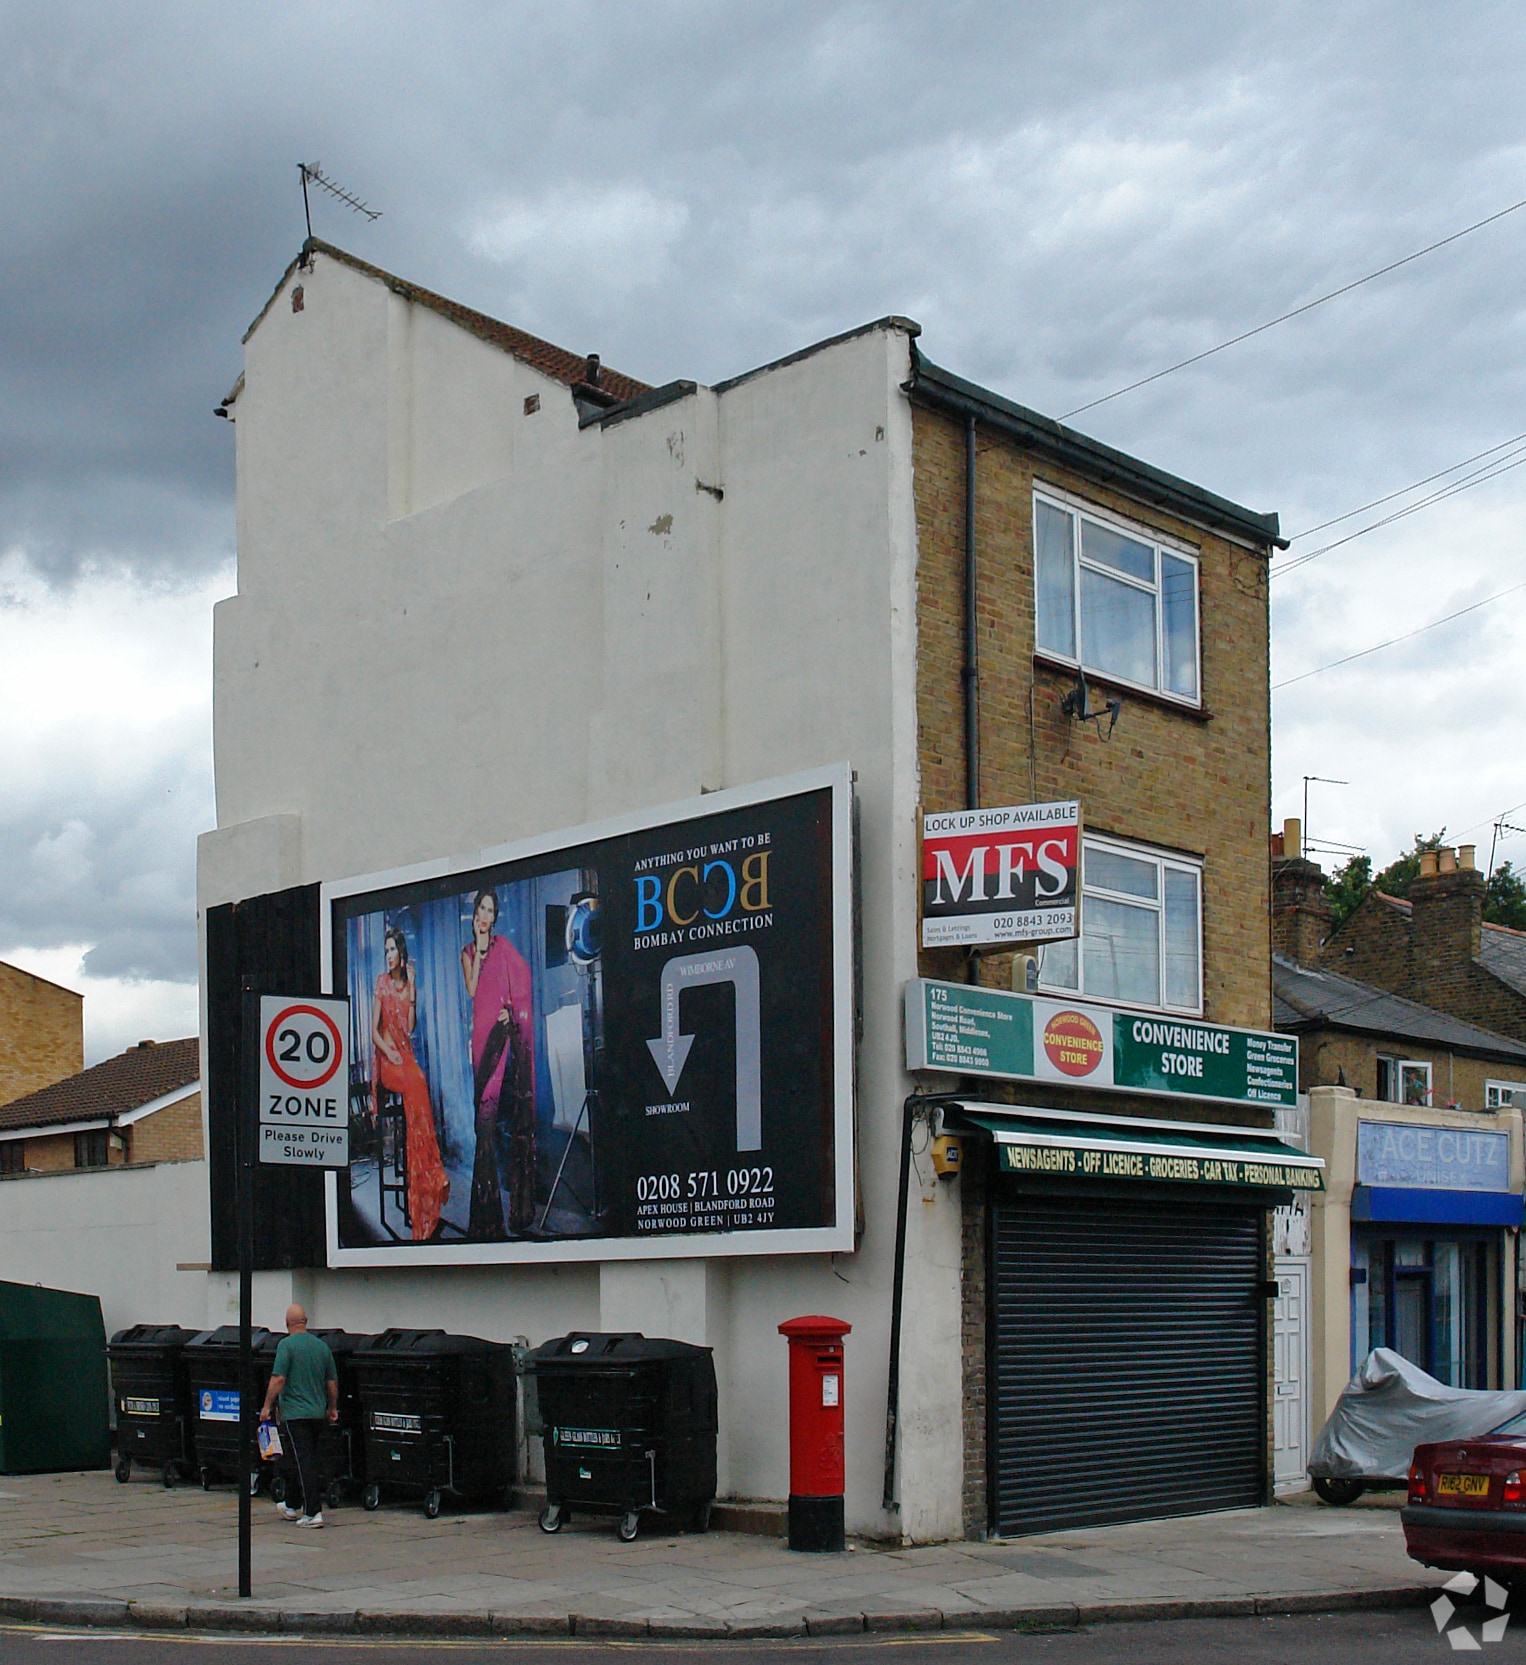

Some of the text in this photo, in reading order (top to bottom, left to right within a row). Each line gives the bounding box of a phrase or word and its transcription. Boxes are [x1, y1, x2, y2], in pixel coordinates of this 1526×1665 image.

[925, 806, 1077, 832] LOCK UP SHOP AVAILABLE
[634, 832, 771, 872] ANYTHING YOU WANT TO BE
[931, 838, 1069, 905] MFS
[993, 913, 1073, 929] 020 8843 2093
[634, 913, 774, 950] BOMBAY CONNECTION
[994, 927, 1072, 938] www.mfs-group.com
[680, 957, 736, 977] WIMBORNE AV
[930, 988, 948, 1001] 175
[931, 1001, 958, 1013] Norwood
[931, 1011, 958, 1023] Norwood
[278, 1029, 330, 1064] 20
[666, 1001, 675, 1077] BLANDFORD
[1044, 1032, 1103, 1052] CONVENIENCE
[1132, 1020, 1230, 1055] CONVENIENCE
[1246, 1037, 1292, 1053] Money Transfer
[1060, 1051, 1088, 1065] STORE
[1161, 1052, 1204, 1077] STORE
[1246, 1062, 1283, 1077] Newsagents
[1258, 1089, 1282, 1101] Licence
[269, 1095, 337, 1118] ZONE
[645, 1101, 690, 1116] SHOWROOM
[265, 1129, 343, 1144] Please Drive
[283, 1146, 325, 1160] Slowly
[1381, 1129, 1498, 1166] ACE CUTZ
[1007, 1146, 1321, 1189] NEWSAGENTS OFF LICENCE GROCERIES CAR TAX PERSONAL BANKING
[637, 1166, 774, 1201] 0208 571 0922
[637, 1197, 775, 1216] APEX HOUSE BLANDFORD ROAD
[637, 1212, 775, 1230] NORWOOD GREEN UB2 4JY
